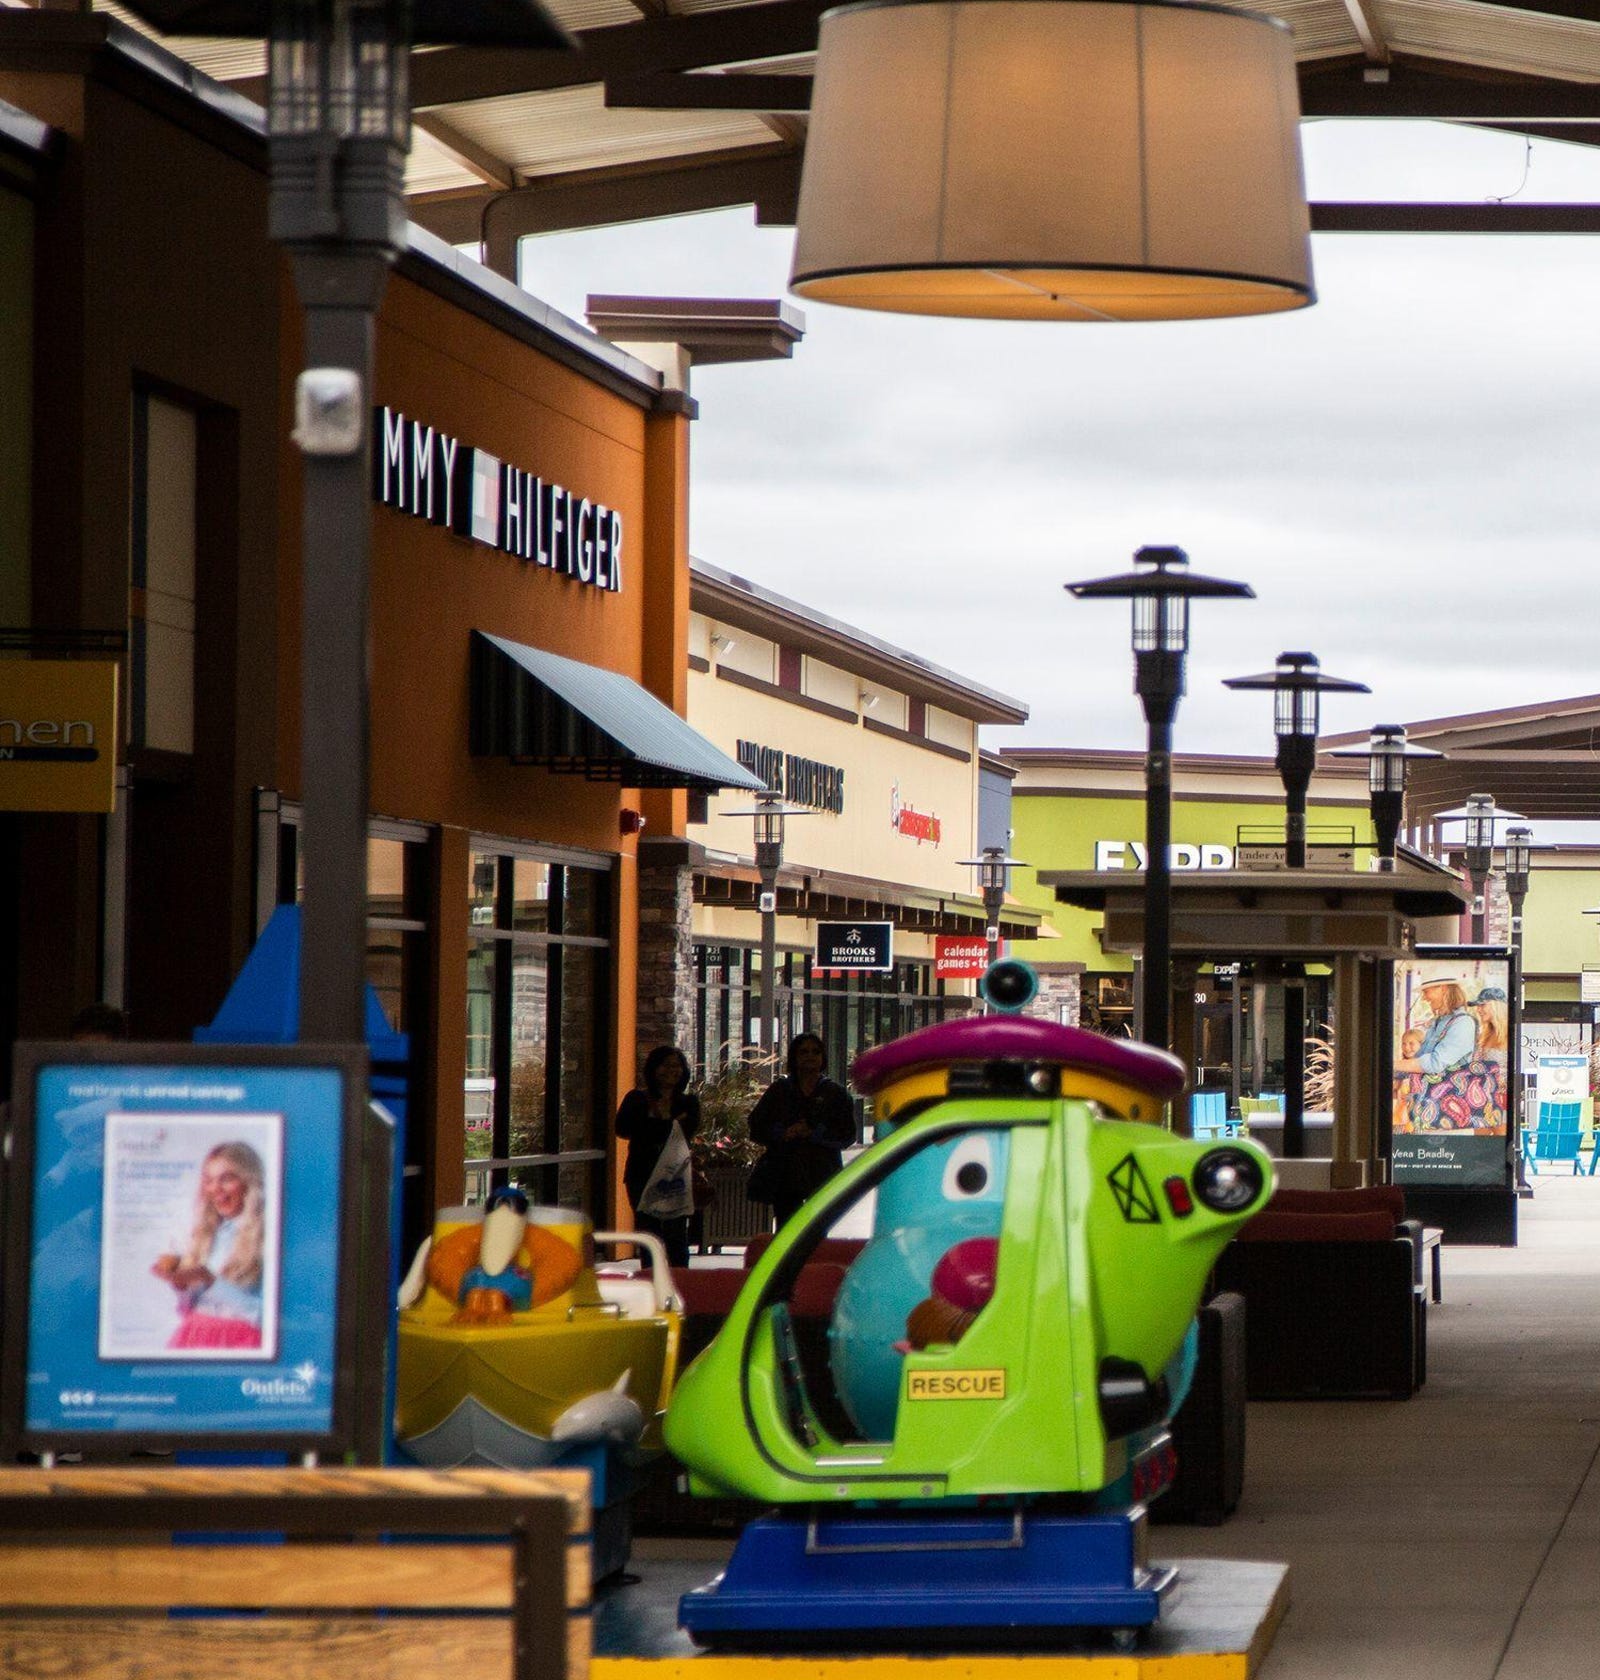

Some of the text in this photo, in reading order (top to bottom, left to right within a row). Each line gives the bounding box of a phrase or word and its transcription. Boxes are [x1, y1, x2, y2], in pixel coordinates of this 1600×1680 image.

[384, 405, 623, 593] MMY HILFIGER
[1238, 850, 1314, 860] Under Arr
[831, 947, 876, 956] BROOKS
[944, 945, 988, 957] calendar
[937, 959, 970, 969] games
[1194, 992, 1206, 1004] 30
[1392, 1148, 1455, 1161] Vera Bradley
[241, 1379, 306, 1397] Outlets
[912, 1376, 1002, 1394] RESCUE
